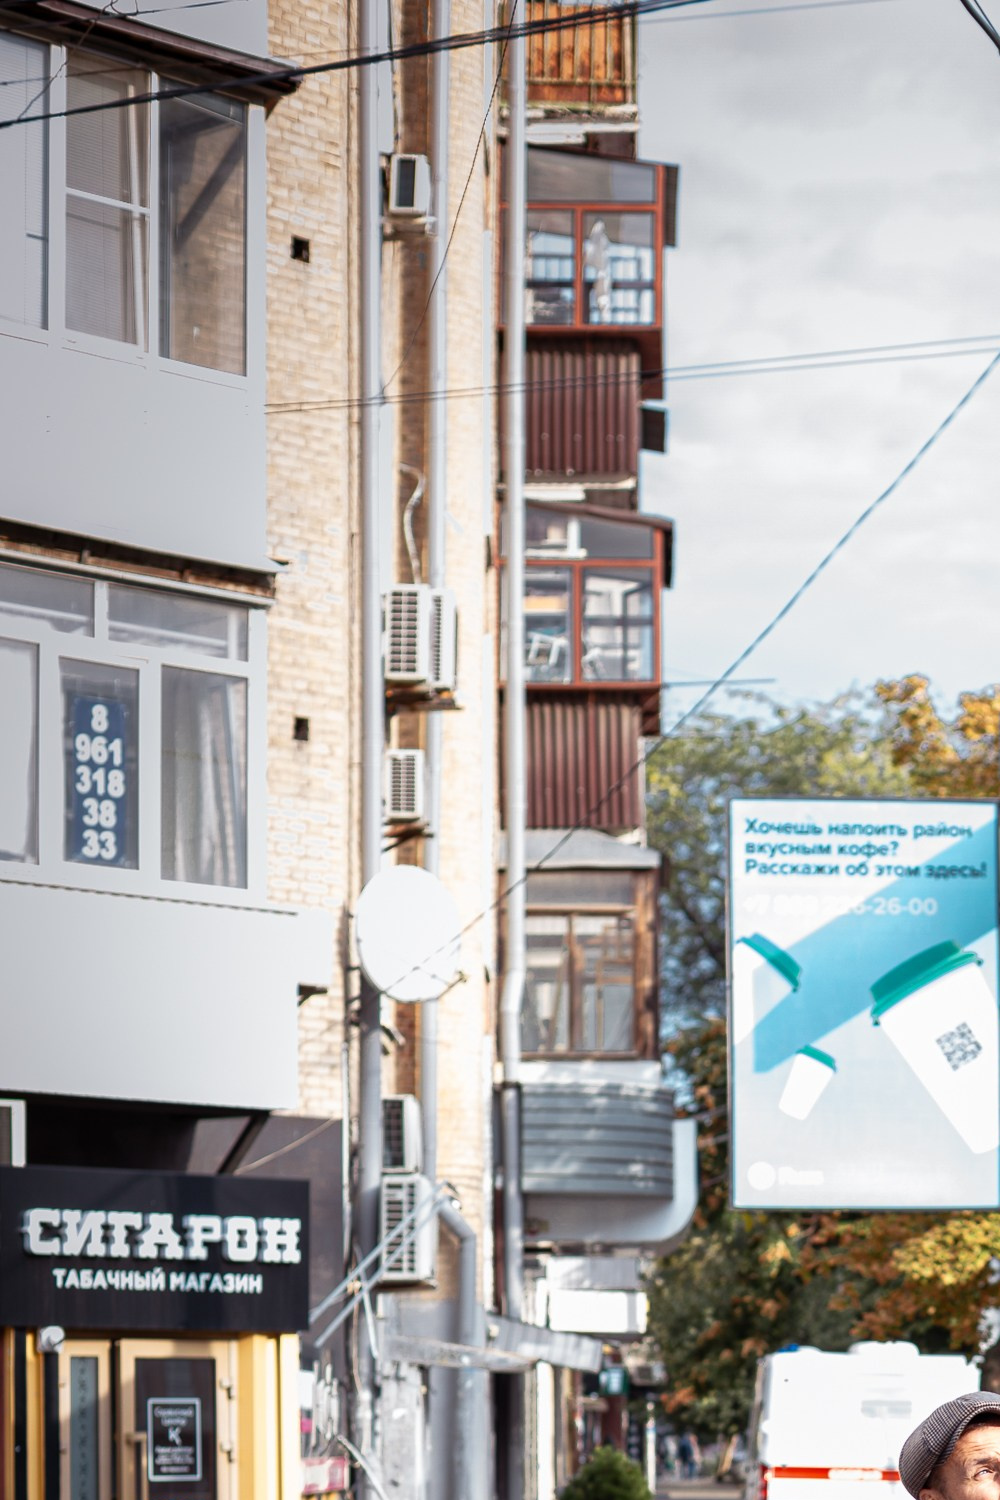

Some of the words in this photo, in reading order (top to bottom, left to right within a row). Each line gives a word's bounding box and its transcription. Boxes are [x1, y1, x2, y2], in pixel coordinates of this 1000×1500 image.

[91, 704, 109, 732] 8
[75, 733, 123, 767] 961
[75, 765, 125, 798] 318
[82, 798, 117, 828] 38
[745, 818, 822, 835] Хочешь
[828, 824, 907, 836] напоить
[82, 829, 117, 860] 33
[745, 843, 832, 858] вкусным
[837, 841, 899, 858] кофе?
[745, 859, 840, 875] Расскажи
[845, 862, 869, 876] об
[875, 864, 921, 877] этом
[925, 861, 988, 880] здесь!
[23, 1208, 301, 1264] СИГАРОН
[53, 1267, 166, 1291] ТАБАЧНЫЙ
[169, 1272, 263, 1293] МАГАЗИН
